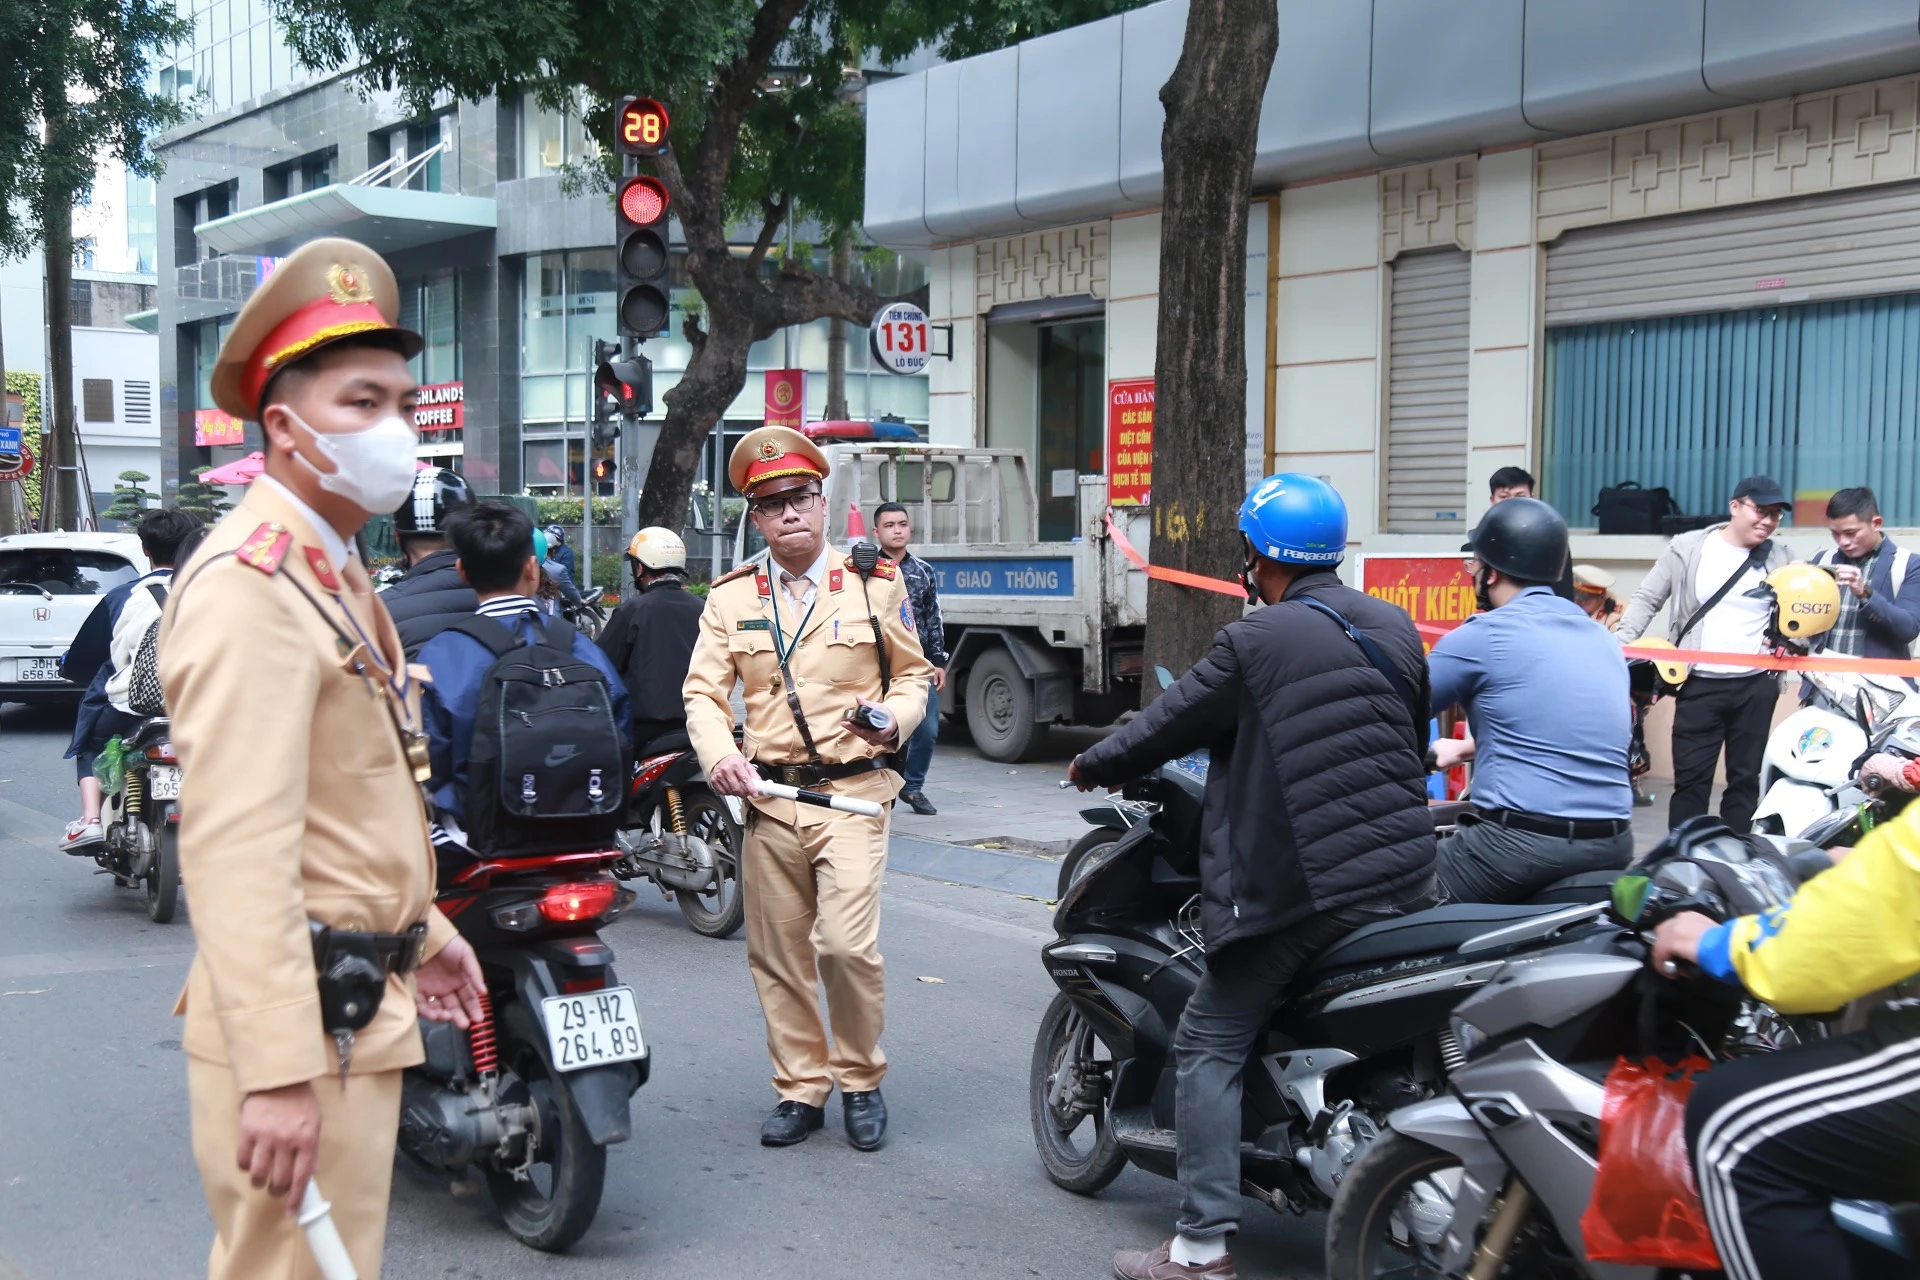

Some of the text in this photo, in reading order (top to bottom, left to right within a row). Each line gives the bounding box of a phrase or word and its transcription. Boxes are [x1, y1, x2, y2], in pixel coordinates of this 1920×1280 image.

[625, 112, 660, 143] 28
[881, 322, 927, 353] 131
[907, 355, 924, 367] ĐÚC
[414, 408, 453, 426] COFFEE
[1122, 409, 1136, 425] CÁC
[0, 440, 18, 450] XANH
[1119, 430, 1136, 448] DIỆT
[1113, 473, 1130, 488] DỊCH
[955, 570, 992, 588] GIAO
[1005, 567, 1059, 589] THÔNG
[1425, 571, 1478, 621] KIỂM
[1791, 602, 1832, 615] CSGT
[1052, 969, 1080, 977] HONDA
[559, 994, 626, 1031] 29-H2
[558, 1025, 639, 1066] 264.89
